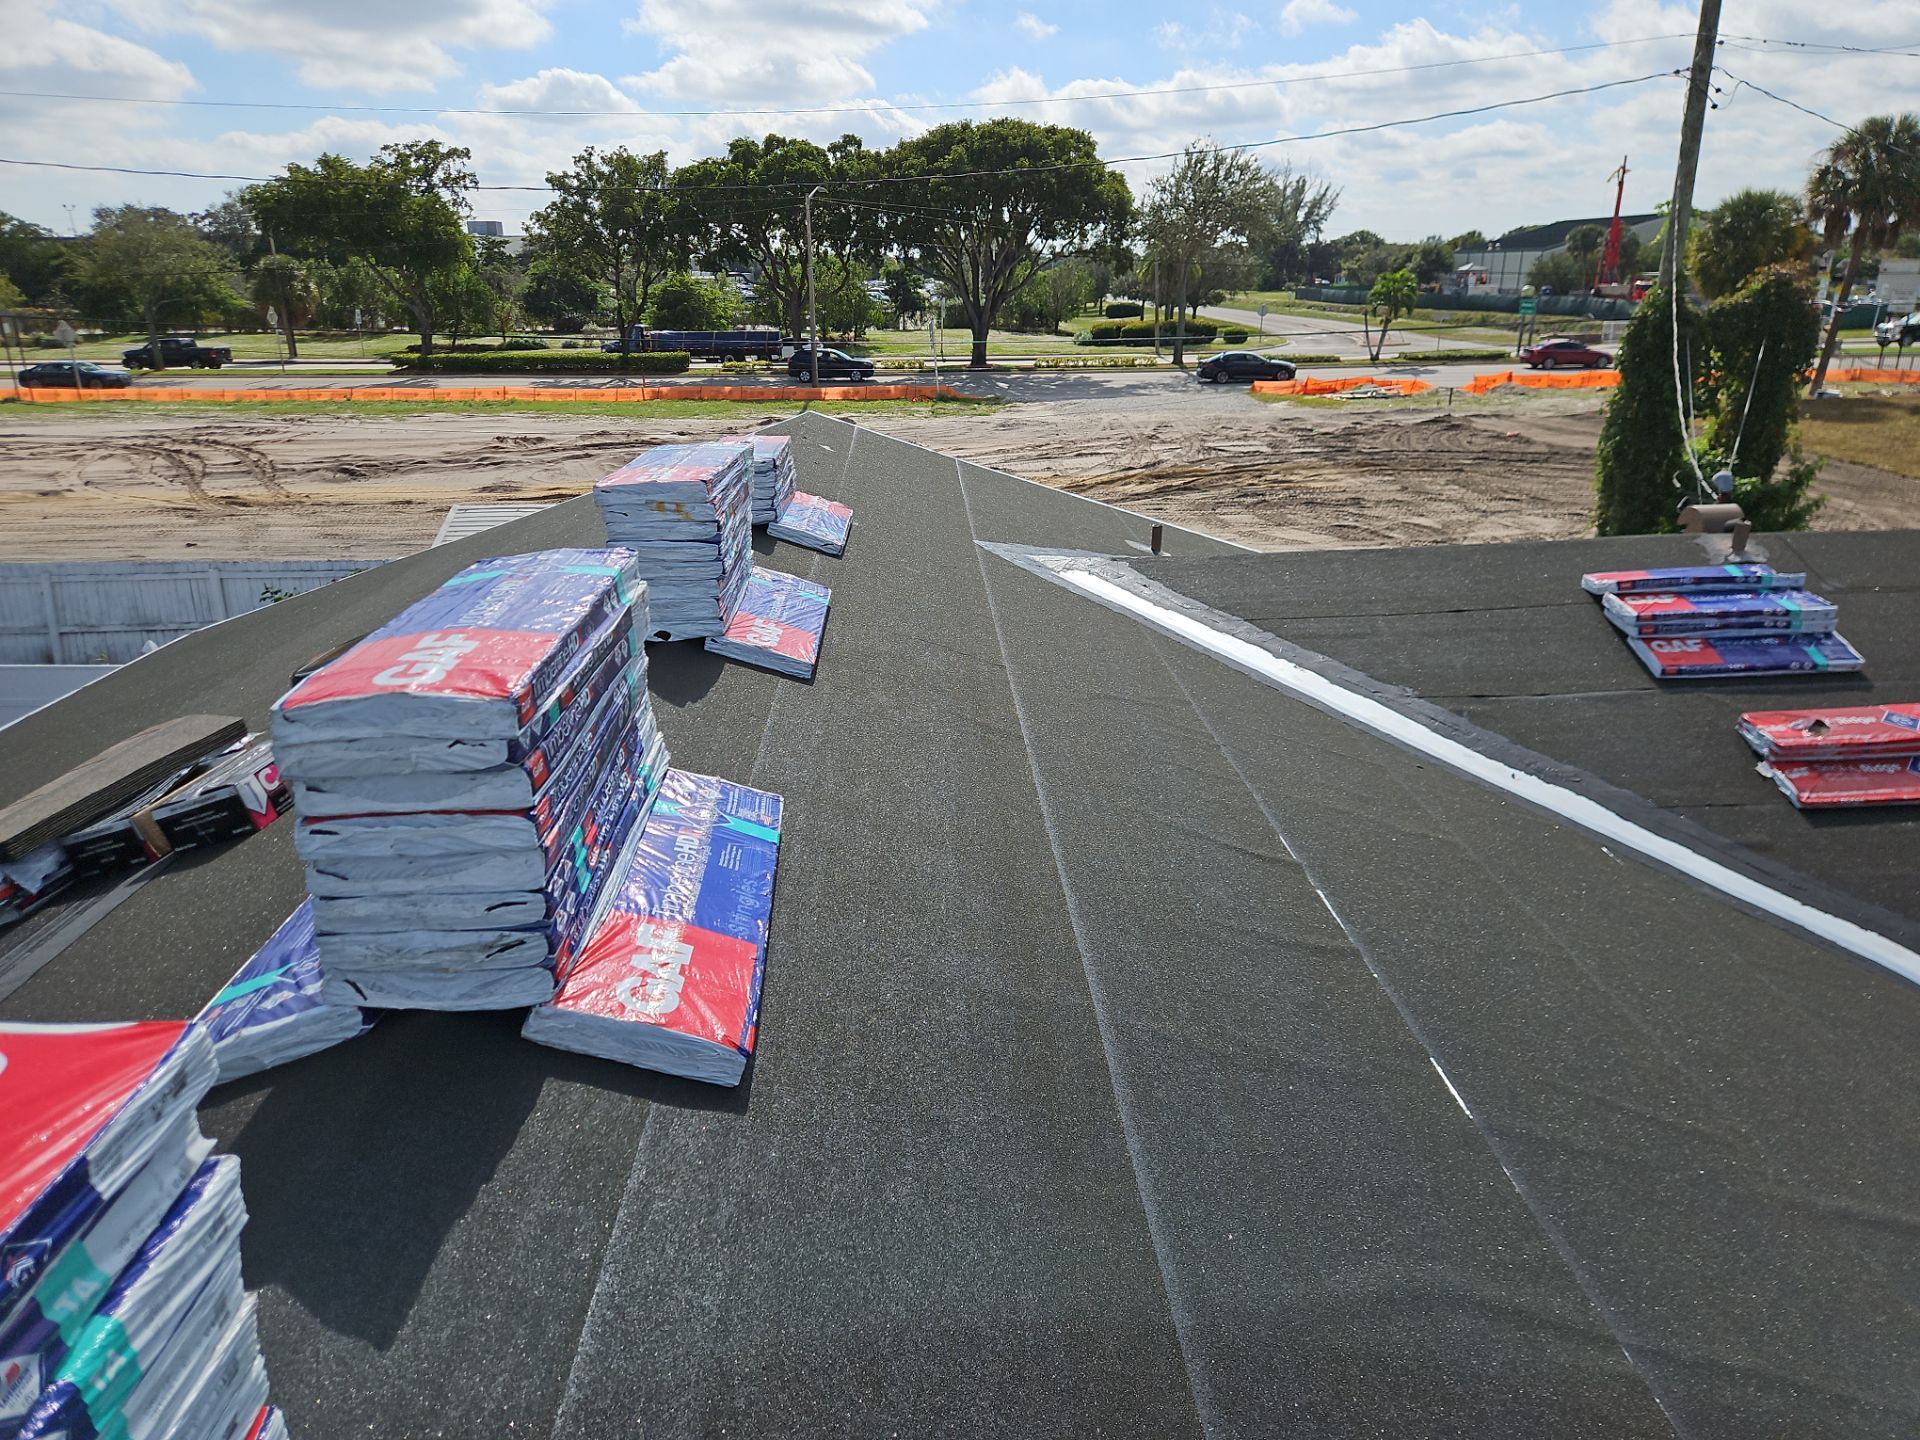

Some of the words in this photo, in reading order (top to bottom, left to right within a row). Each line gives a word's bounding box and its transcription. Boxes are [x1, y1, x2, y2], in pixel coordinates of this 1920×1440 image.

[372, 633, 481, 686] GAF
[1650, 639, 1704, 653] GAF
[617, 922, 695, 1014] GAF
